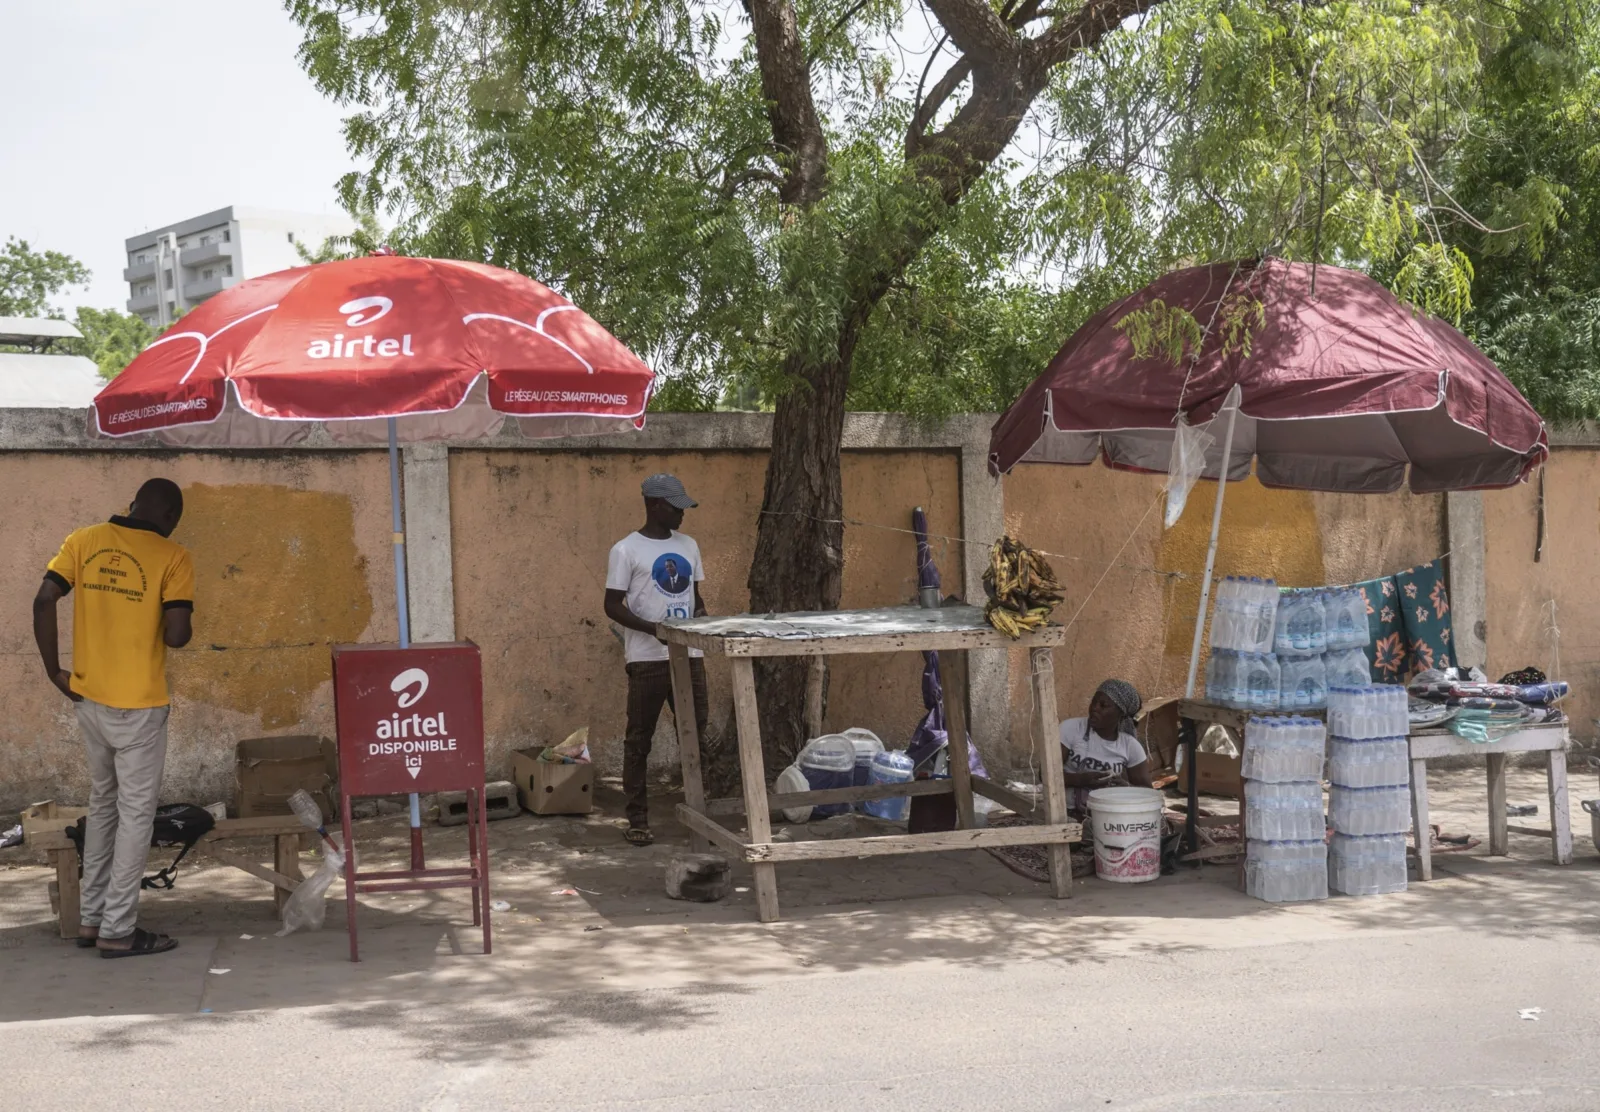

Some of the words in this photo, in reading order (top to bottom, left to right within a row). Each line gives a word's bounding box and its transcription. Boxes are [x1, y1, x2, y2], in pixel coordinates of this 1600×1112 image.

[307, 333, 415, 359] airtel
[505, 391, 514, 402] LE
[514, 388, 542, 401] RÉSEAU
[543, 391, 560, 401] DES
[560, 392, 628, 405] SMARTPHONES
[109, 414, 118, 424] LE
[143, 406, 155, 417] DES
[102, 584, 110, 592] ET
[376, 712, 448, 739] airtel
[369, 739, 457, 755] DISPONIBLE
[405, 755, 422, 767] ici
